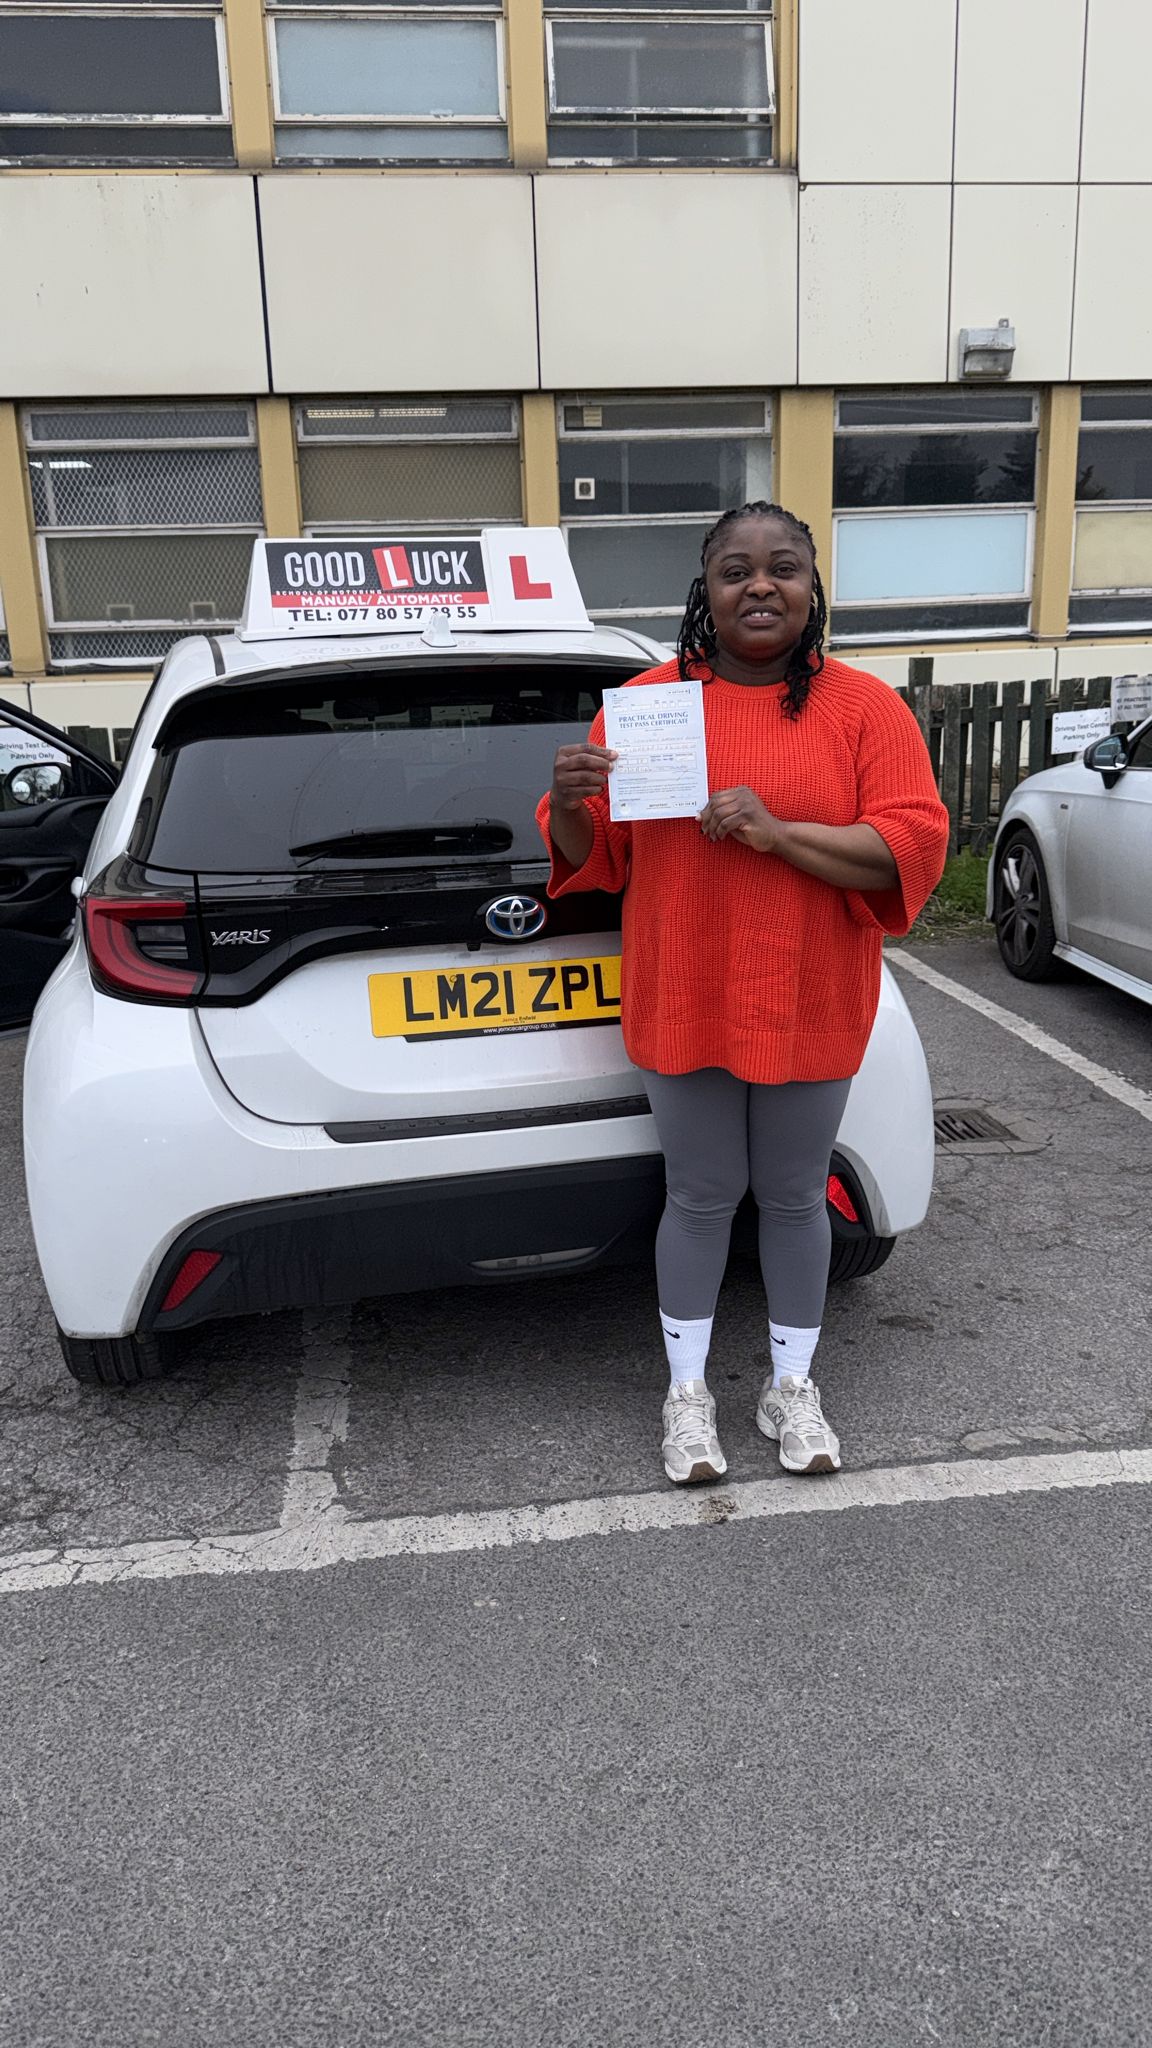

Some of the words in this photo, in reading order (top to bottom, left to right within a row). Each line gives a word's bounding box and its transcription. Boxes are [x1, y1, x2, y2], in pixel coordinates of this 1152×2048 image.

[284, 551, 365, 587] GOOD
[381, 548, 473, 589] LUCK
[509, 555, 553, 600] L
[301, 595, 372, 606] MANUAL/
[377, 593, 463, 605] AUTOMATIC
[288, 608, 332, 622] TEL:
[338, 608, 369, 620] 077
[376, 607, 397, 620] 80
[404, 607, 423, 619] 57
[457, 606, 477, 618] 55
[618, 713, 656, 722] PRACTICAL
[657, 711, 689, 720] DRIVING
[402, 970, 515, 1022] LM21
[528, 962, 621, 1013] ZPL
